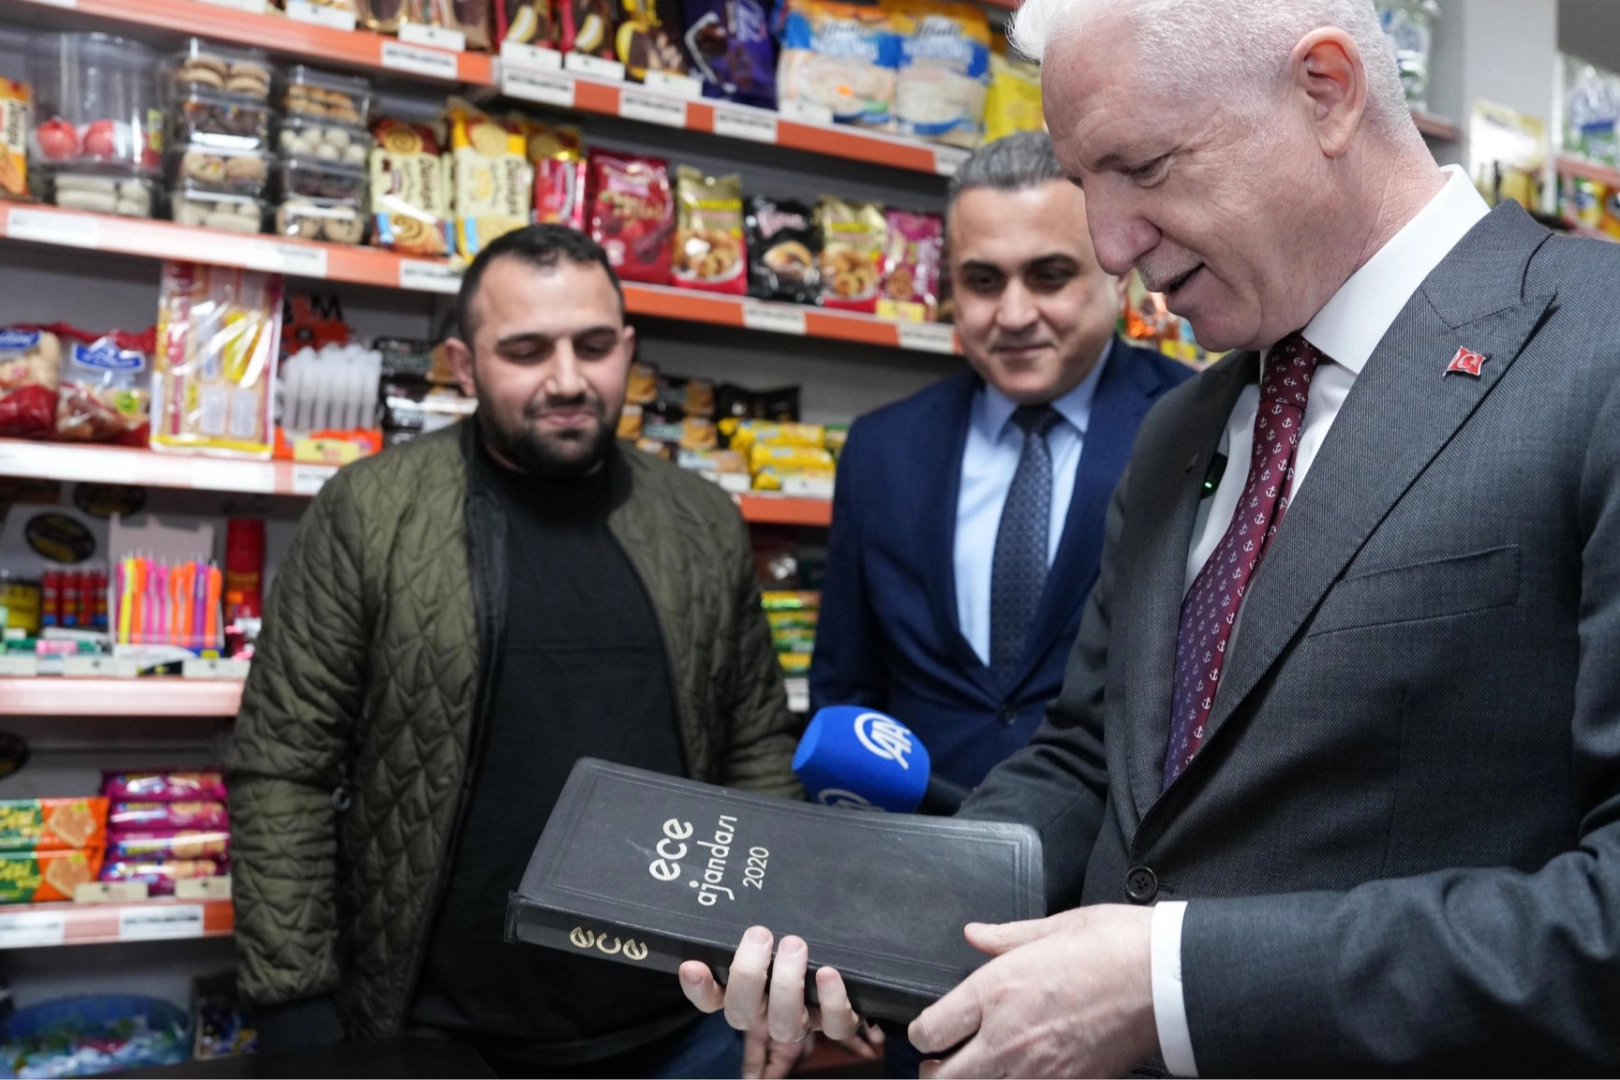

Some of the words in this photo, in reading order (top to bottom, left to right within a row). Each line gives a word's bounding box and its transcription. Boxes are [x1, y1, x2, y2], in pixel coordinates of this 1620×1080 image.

[871, 720, 912, 771] AA
[649, 818, 694, 881] ece
[689, 815, 738, 906] ajandası
[742, 846, 769, 890] 2020
[569, 926, 648, 960] ece
